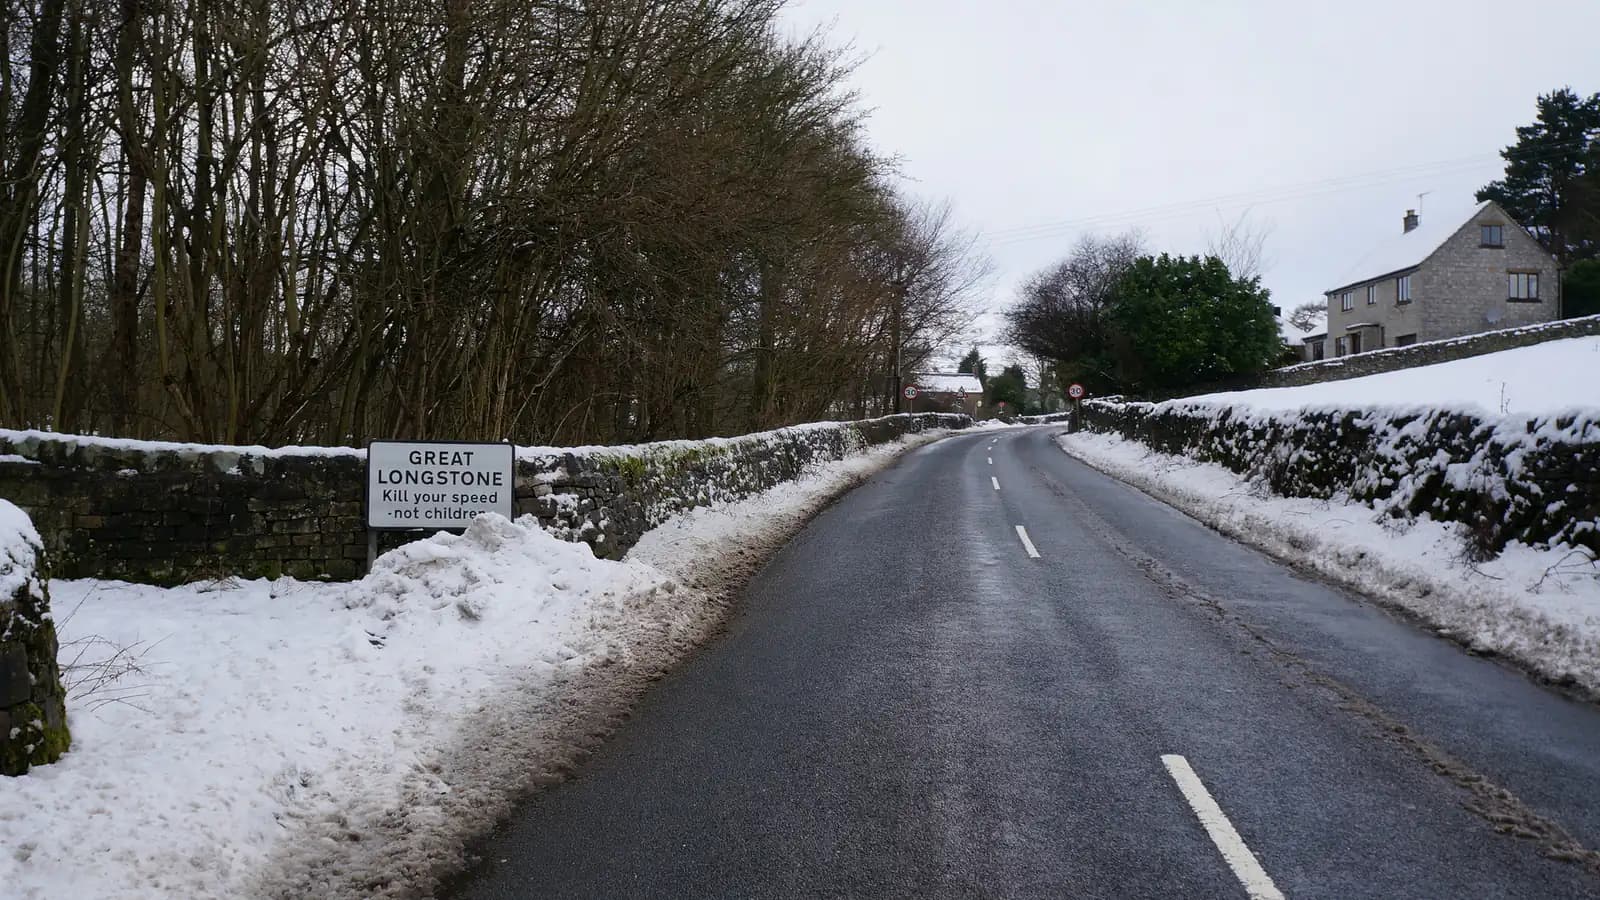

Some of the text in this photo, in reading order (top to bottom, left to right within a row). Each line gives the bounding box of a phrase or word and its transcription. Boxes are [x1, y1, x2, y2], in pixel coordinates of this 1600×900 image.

[1070, 387, 1081, 395] 30
[409, 451, 474, 466] GREAT
[378, 469, 503, 486] LONGSTONE
[383, 489, 498, 505] Kill your speed
